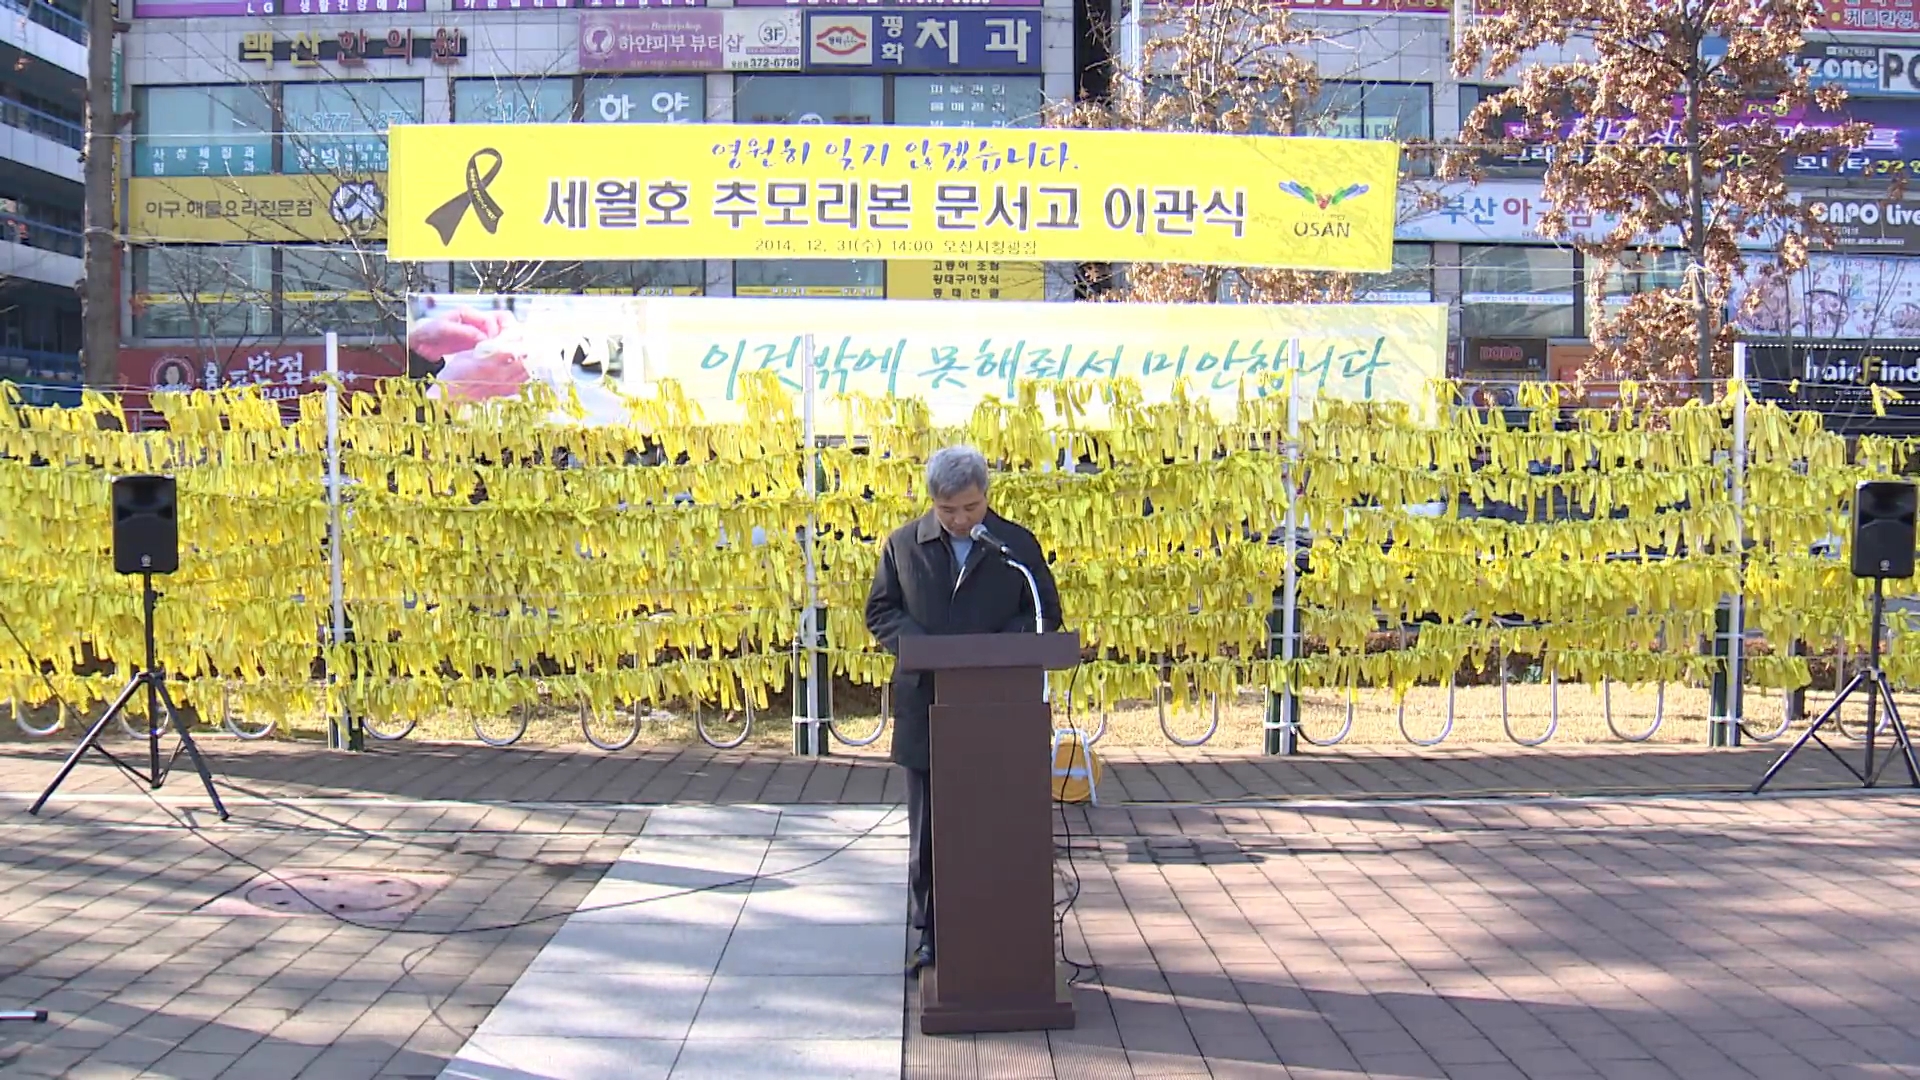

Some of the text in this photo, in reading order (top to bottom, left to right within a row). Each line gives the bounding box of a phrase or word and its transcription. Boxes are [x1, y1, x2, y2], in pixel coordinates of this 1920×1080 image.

[763, 27, 783, 41] 3F
[914, 18, 1032, 64] 치과
[712, 138, 1079, 173] 영원히 잊지 않겠습니다.
[543, 181, 690, 229] 세월호
[713, 181, 911, 229] 추모리본
[935, 185, 1080, 230] 문서고
[1104, 187, 1245, 237] 이관식
[755, 240, 796, 252] 2014.
[893, 240, 933, 251] 14:00
[1294, 222, 1350, 238] OSAN
[1141, 336, 1391, 399] 미안합니다
